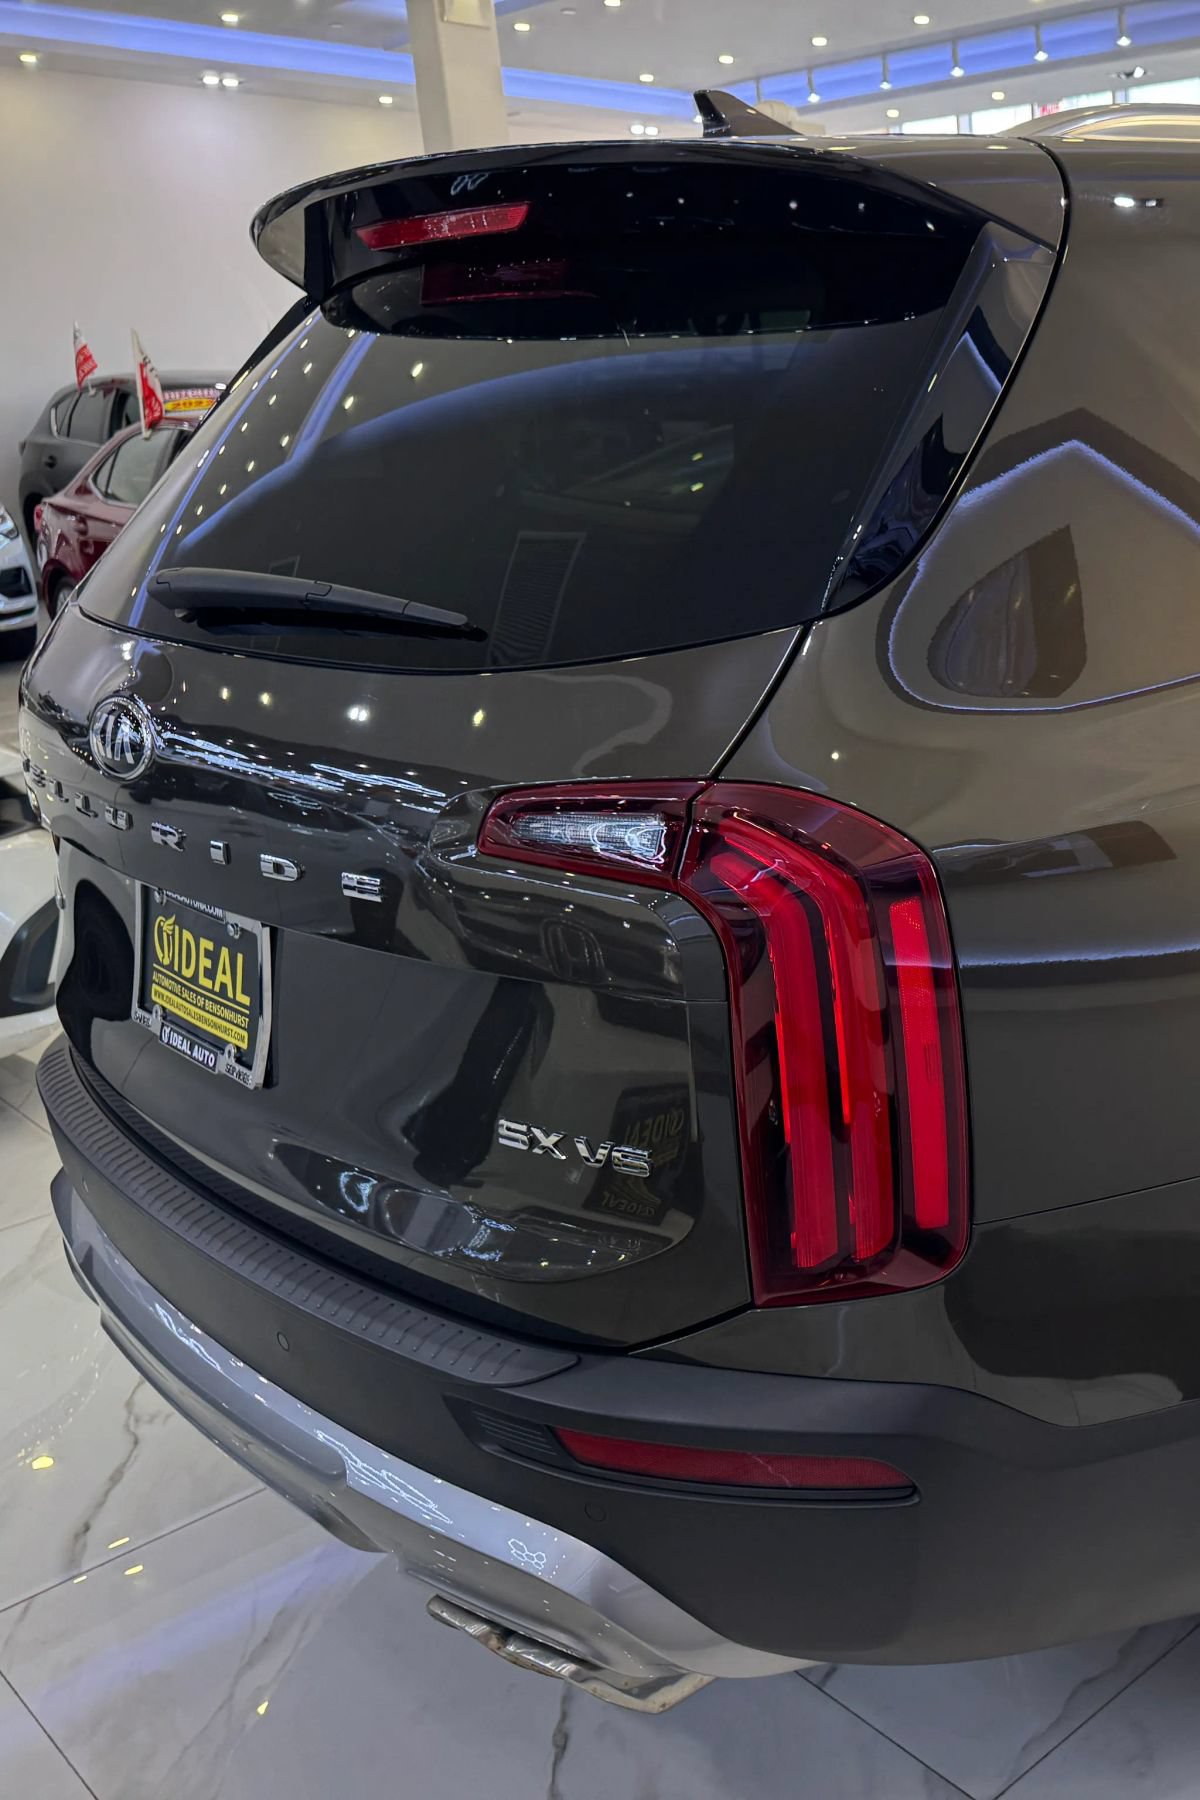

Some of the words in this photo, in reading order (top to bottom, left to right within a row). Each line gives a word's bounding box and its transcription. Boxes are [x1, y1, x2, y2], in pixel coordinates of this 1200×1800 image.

[174, 924, 250, 1006] IDEAL
[152, 971, 182, 995] AUTOMOTIVE
[182, 984, 197, 1003] SALES
[196, 994, 205, 1008] OF
[205, 999, 250, 1029] BENSONHURST
[169, 1031, 191, 1055] IDEAL
[192, 1047, 215, 1068] AUTO
[498, 1119, 567, 1160] SX
[574, 1136, 653, 1178] V6
